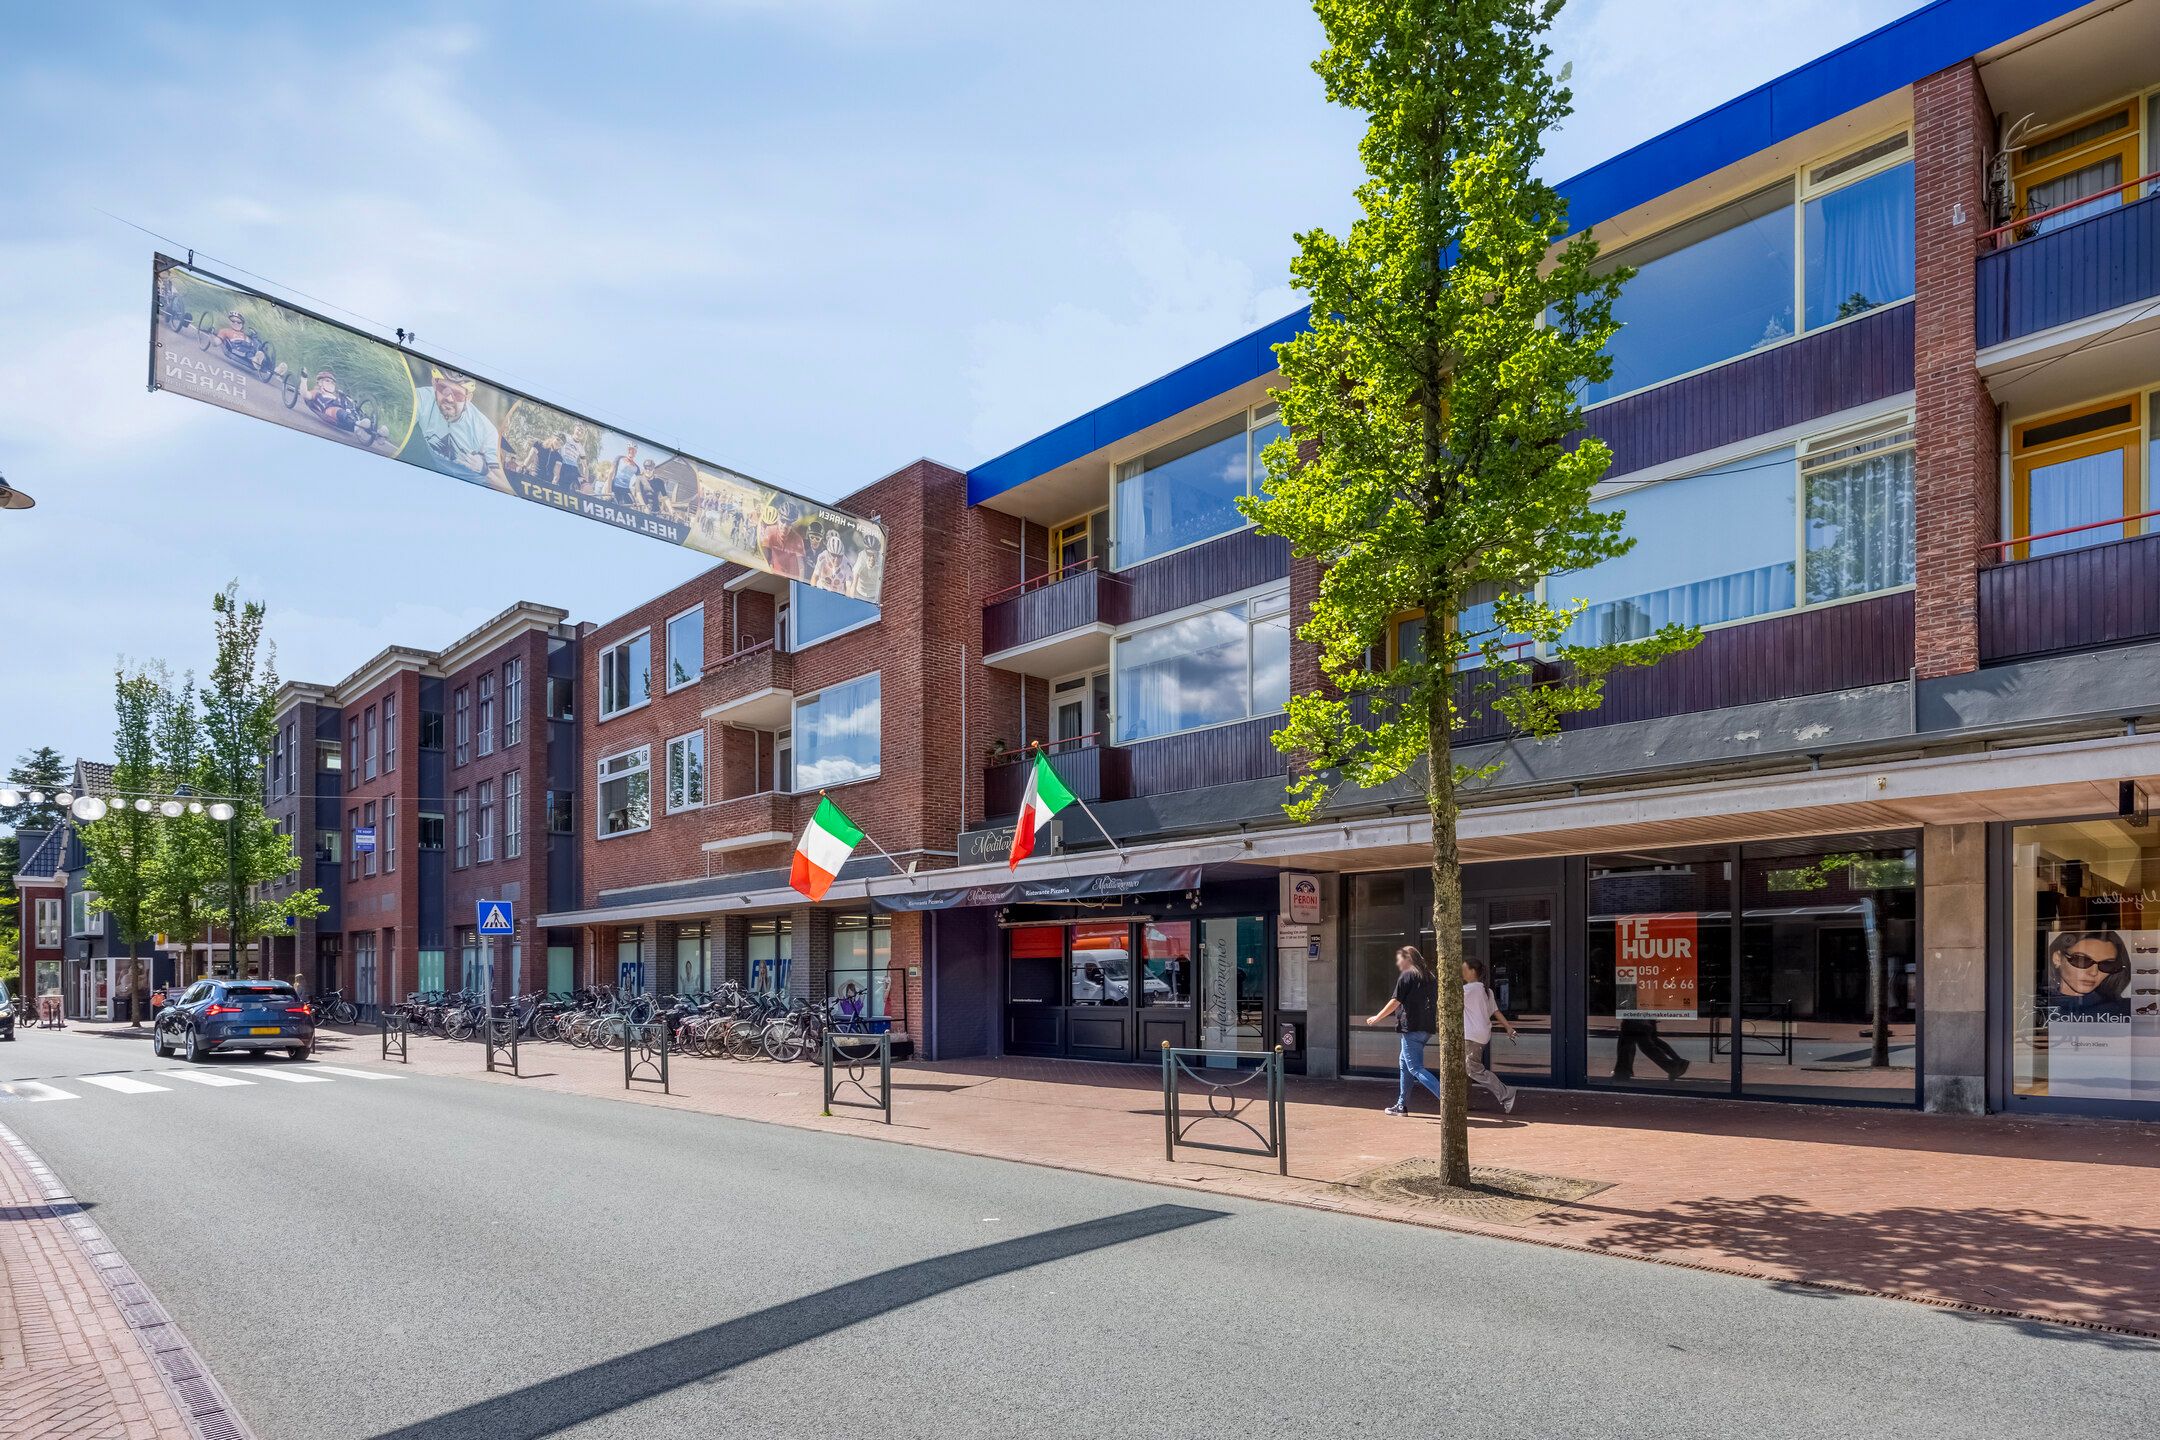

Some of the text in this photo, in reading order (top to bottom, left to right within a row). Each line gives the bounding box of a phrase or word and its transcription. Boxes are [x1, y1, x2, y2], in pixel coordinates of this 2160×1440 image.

[1050, 886, 1070, 894] Pizzeria
[1293, 894, 1318, 905] PERONI
[1618, 918, 1650, 939] TE
[1622, 938, 1692, 959] HUUR
[1617, 966, 1659, 977] OC 050
[1639, 980, 1658, 989] 311
[1663, 980, 1676, 989] 66
[1680, 980, 1694, 989] 66
[2048, 1012, 2131, 1023] Calvin Klein
